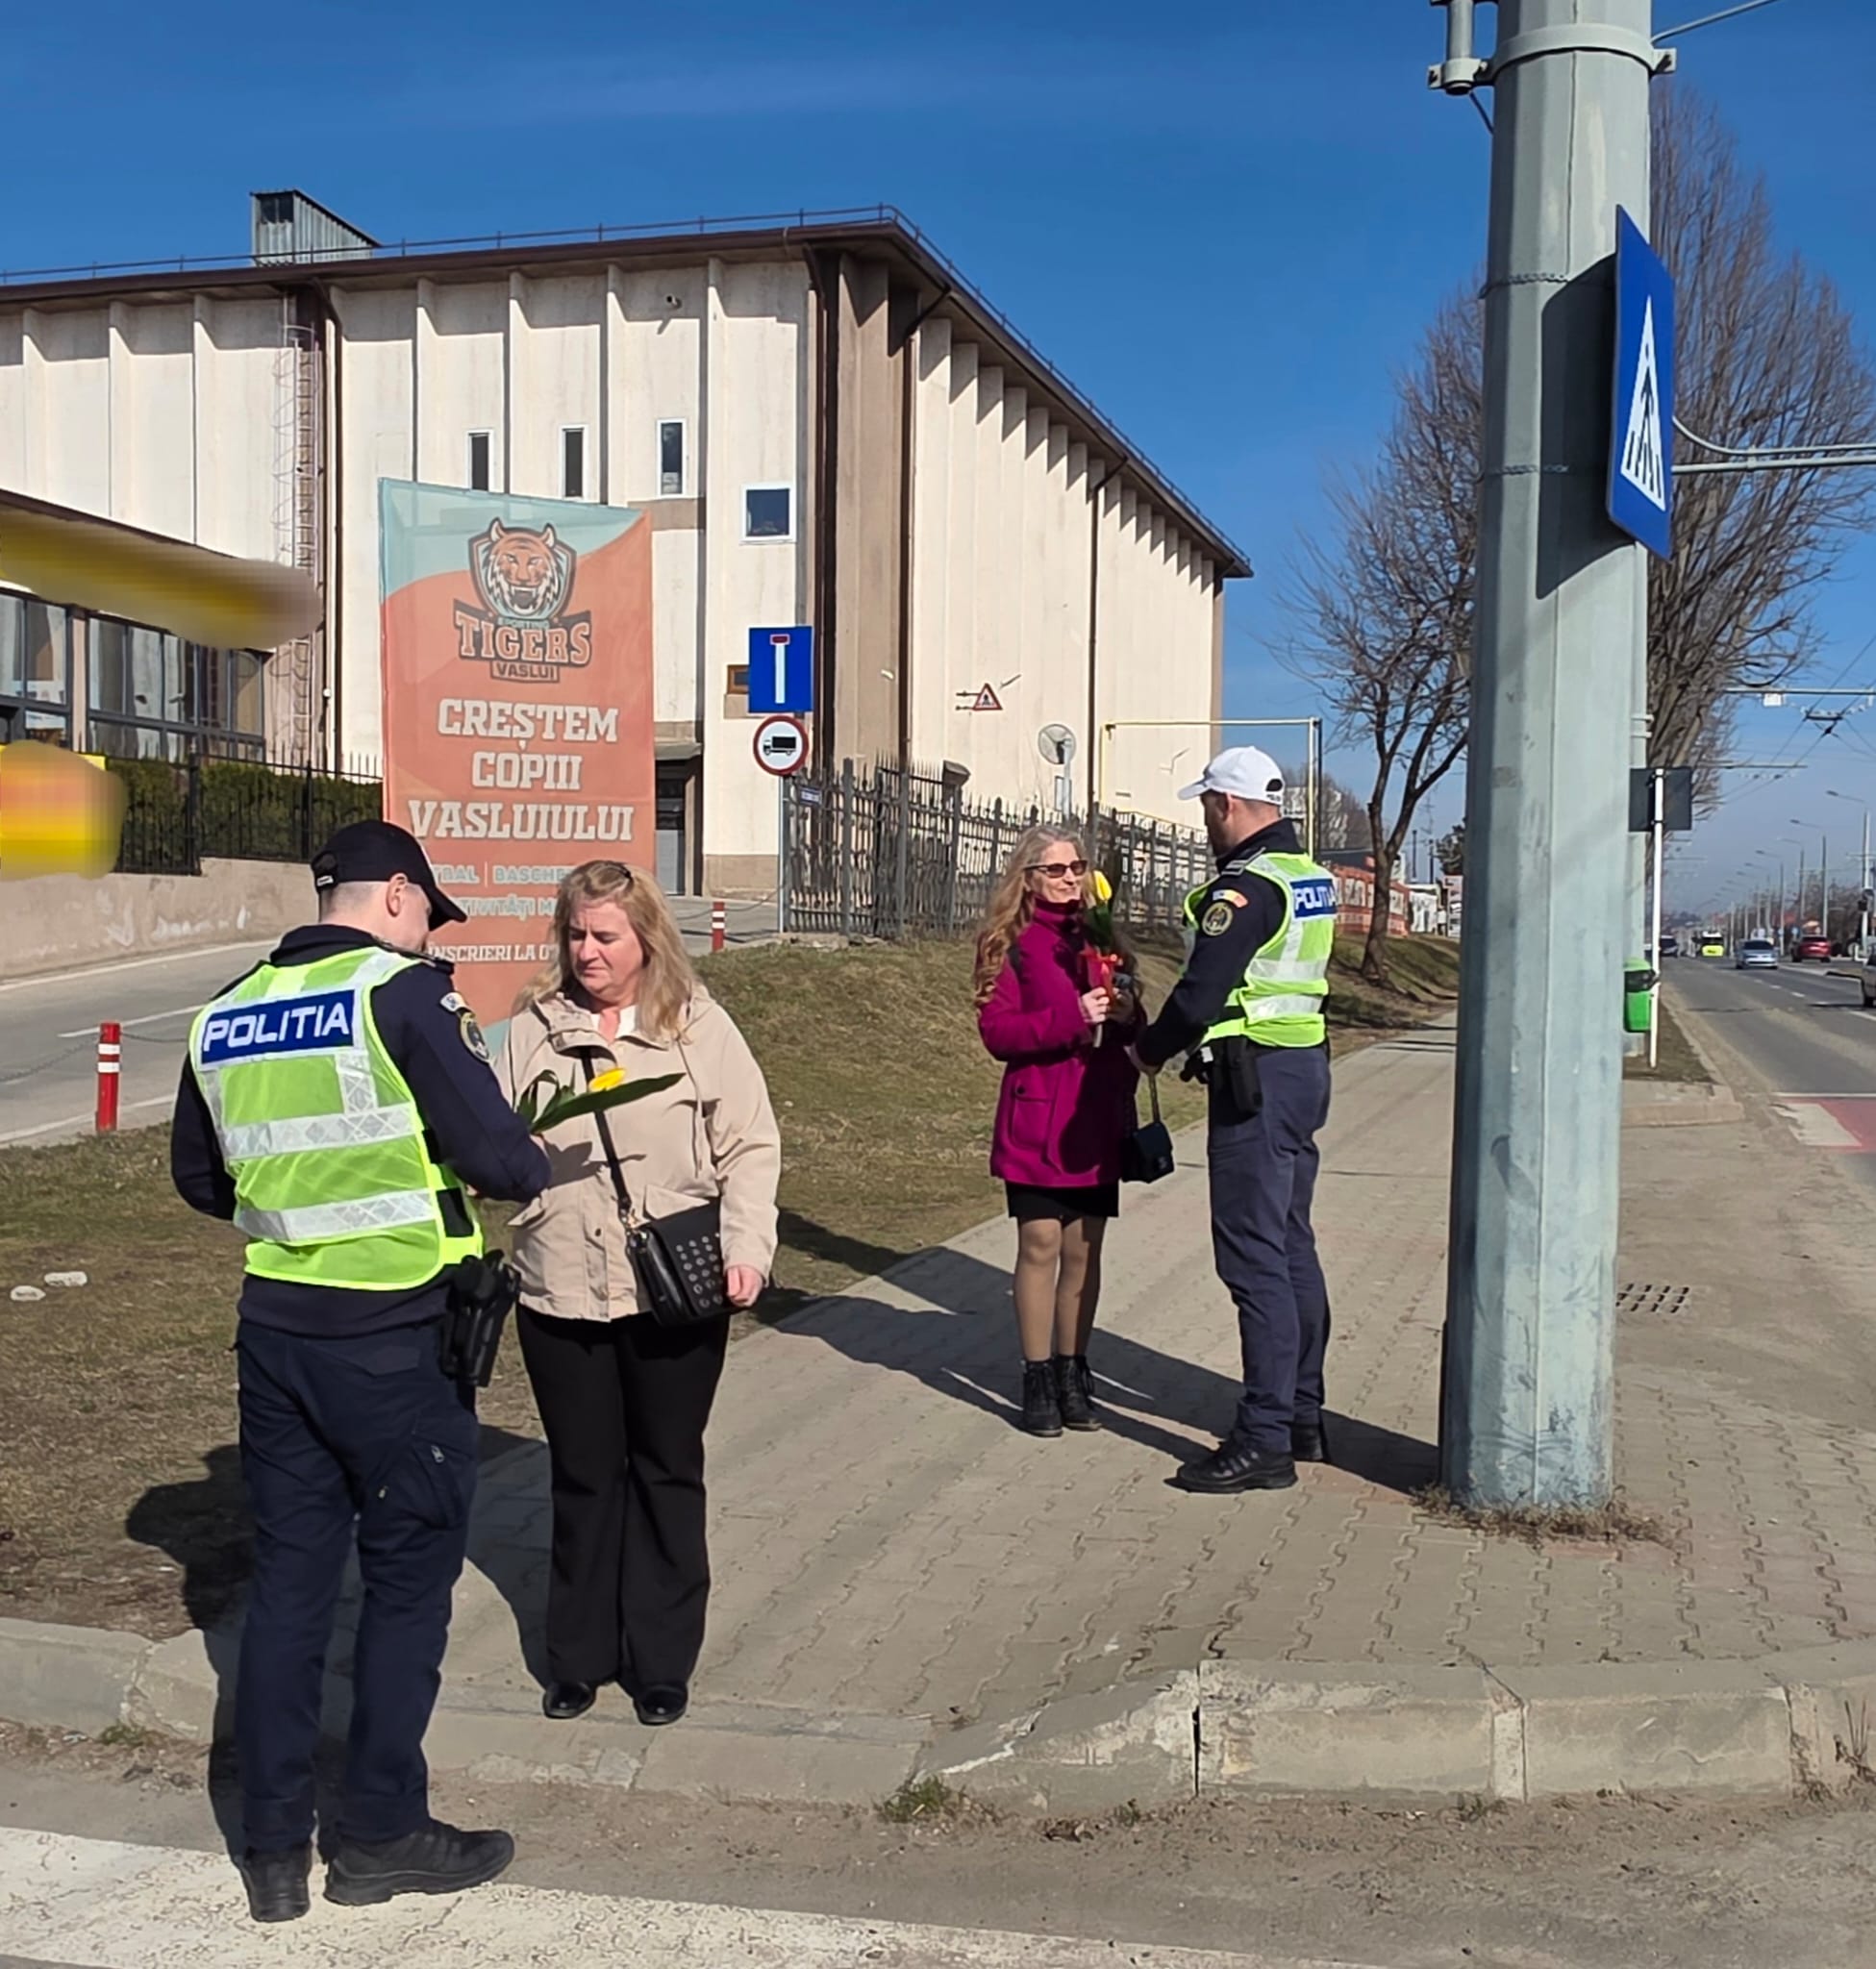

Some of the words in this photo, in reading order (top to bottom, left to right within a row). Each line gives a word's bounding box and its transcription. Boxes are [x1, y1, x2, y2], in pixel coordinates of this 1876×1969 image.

[455, 610, 589, 665] TIGERS
[496, 661, 555, 679] VASLUI
[472, 751, 582, 789] COPIII
[408, 800, 634, 840] VASLUIULUI
[492, 865, 574, 884] BASCHE
[513, 944, 536, 961] LA
[202, 1002, 350, 1052] POLITIA
